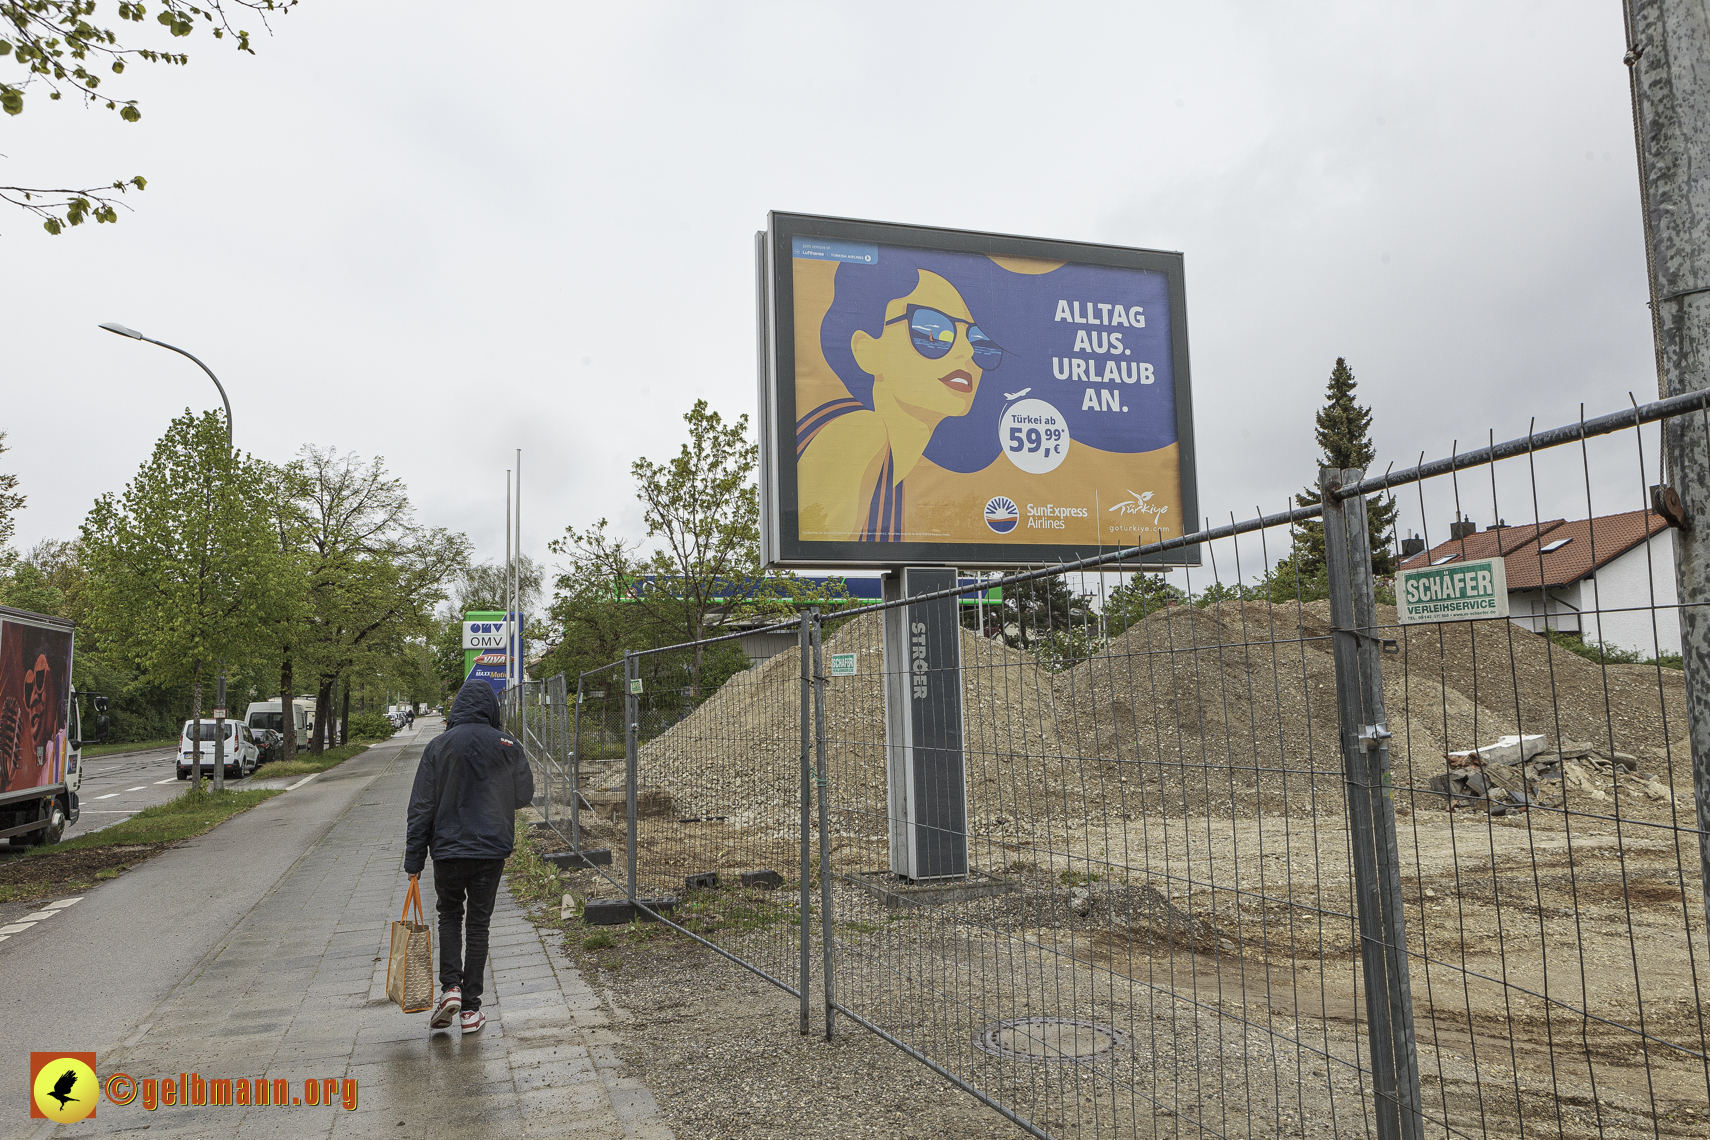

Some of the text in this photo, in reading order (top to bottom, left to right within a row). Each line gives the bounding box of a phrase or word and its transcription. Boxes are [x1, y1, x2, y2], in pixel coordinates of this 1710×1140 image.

[1054, 299, 1146, 328] ALLTAG
[1073, 330, 1131, 356] AUS.
[1052, 357, 1155, 385] URLAUB
[1081, 388, 1129, 413] AN.
[1011, 414, 1056, 426] Türkei ab
[1026, 503, 1088, 520] SunExpress
[1108, 500, 1169, 526] Türkiye
[1027, 516, 1066, 529] Airlines
[1109, 524, 1170, 534] goturkiye.com
[1406, 570, 1493, 603] SCHÄFER
[1407, 599, 1496, 615] VERLEIHSERVICE
[470, 636, 503, 647] OMV
[483, 655, 506, 664] VIVA
[911, 622, 928, 700] STRÖER
